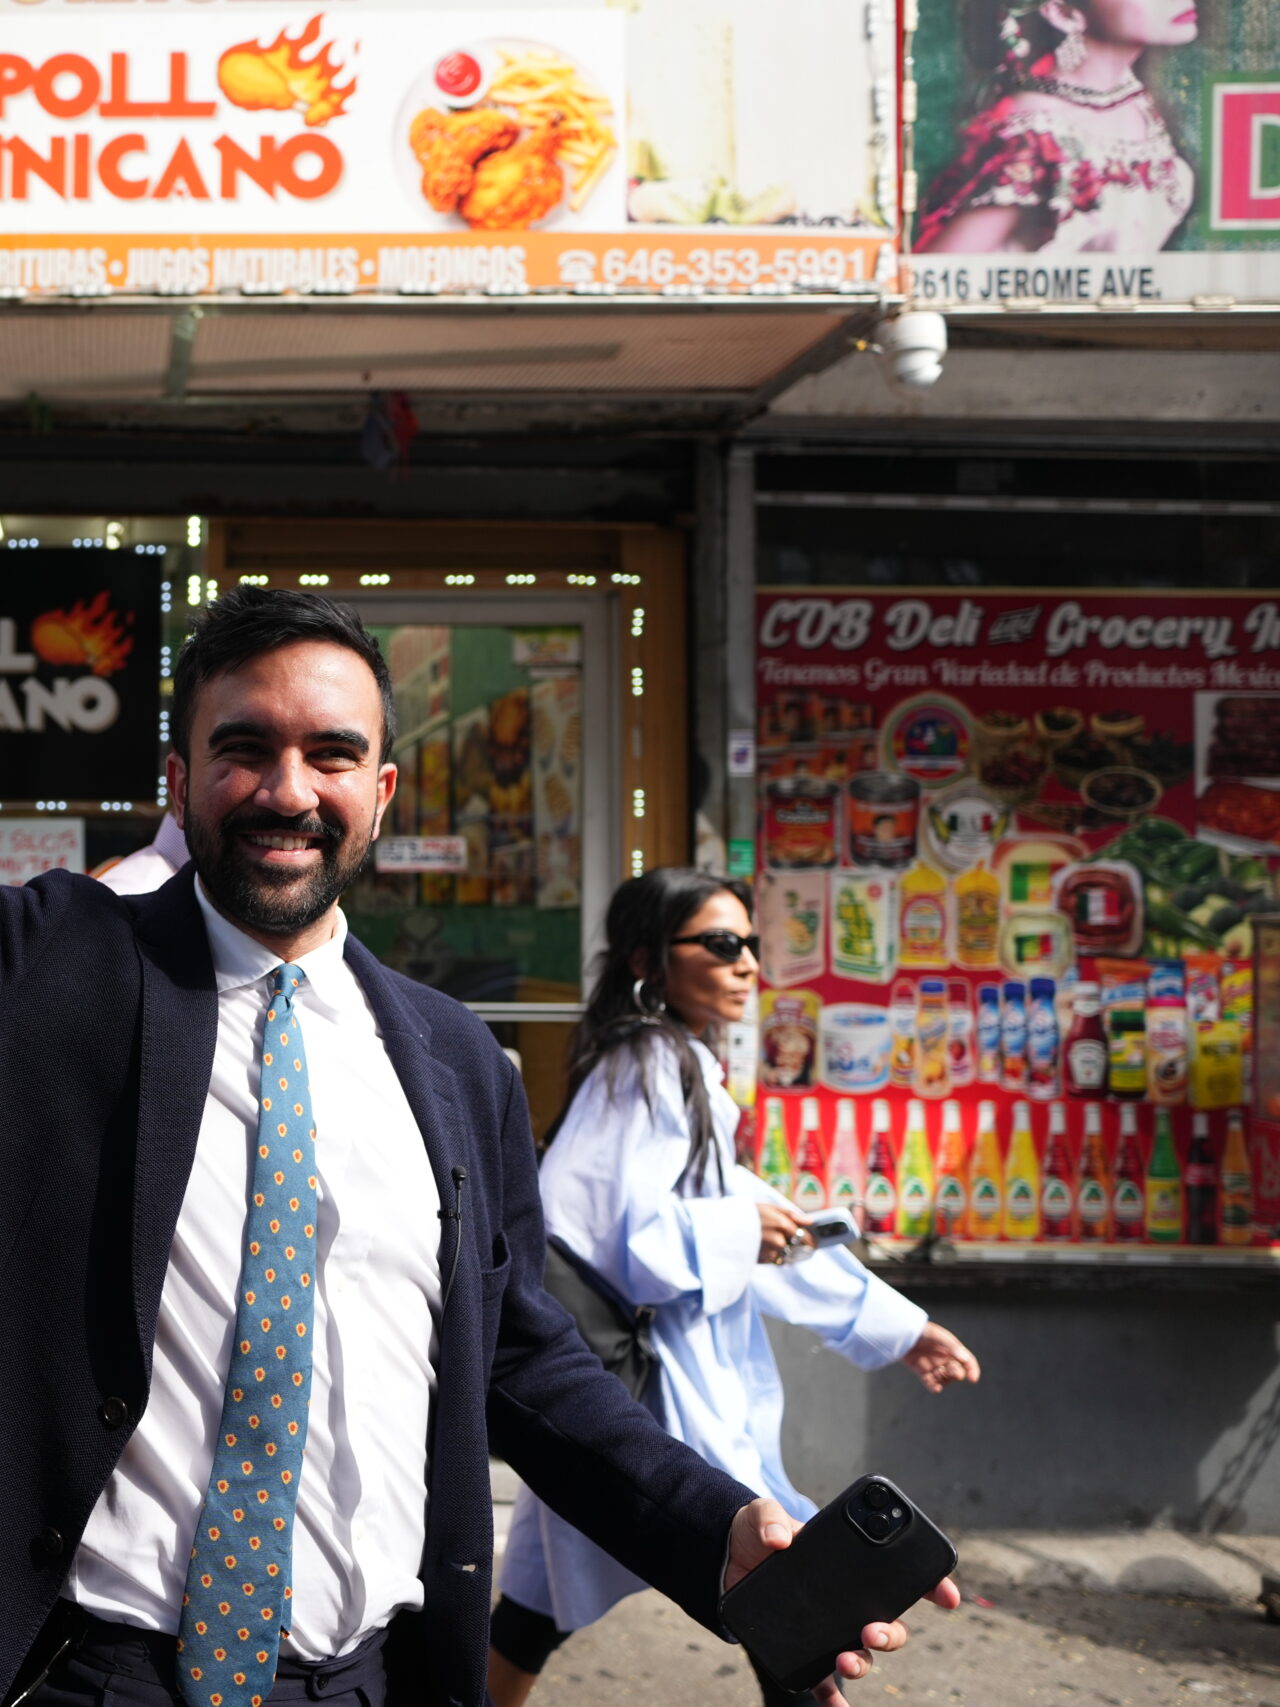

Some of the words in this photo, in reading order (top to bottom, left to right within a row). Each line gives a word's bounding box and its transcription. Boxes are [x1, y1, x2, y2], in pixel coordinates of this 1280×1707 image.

[124, 247, 210, 289] JUGOS
[213, 247, 359, 289] NATURALES
[378, 246, 526, 288] MOFONGOS
[601, 248, 867, 284] 646-353-5991
[980, 267, 1090, 299] JEROME
[1101, 266, 1161, 299] AVE.
[884, 598, 985, 651] Deli
[1045, 600, 1238, 658] Grocery
[758, 657, 861, 686] Tenemos
[864, 657, 927, 691] Gran
[931, 657, 1048, 687] Variedad
[1050, 660, 1079, 687] de
[1083, 658, 1206, 687] Productos
